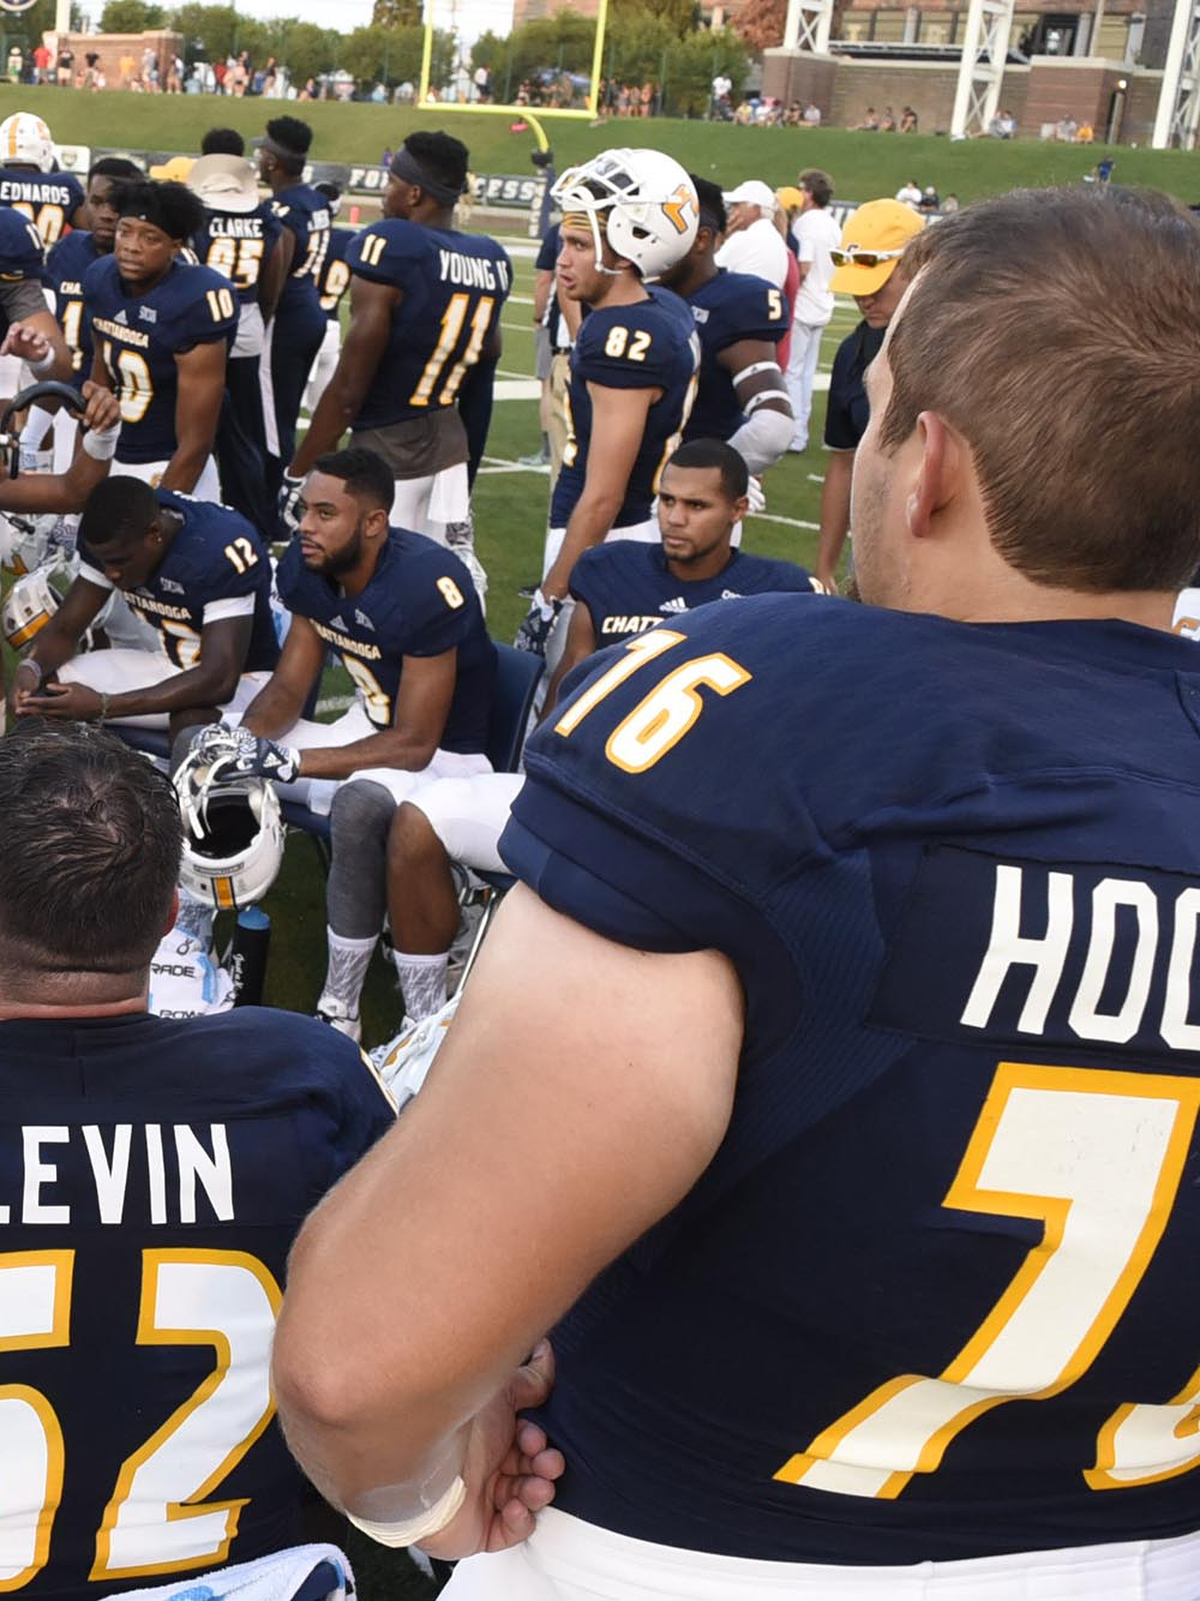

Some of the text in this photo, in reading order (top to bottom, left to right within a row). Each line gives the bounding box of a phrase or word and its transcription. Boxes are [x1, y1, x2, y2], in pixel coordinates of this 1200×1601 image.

[0, 181, 70, 205] EDWARDS
[208, 216, 263, 238] CLARKE
[359, 233, 388, 267] 11
[439, 249, 496, 291] YOUNG
[205, 287, 235, 323] 10
[766, 288, 783, 321] 5
[409, 293, 495, 406] 11
[604, 325, 652, 362] 82
[224, 536, 259, 575] 12
[435, 575, 465, 610] 8
